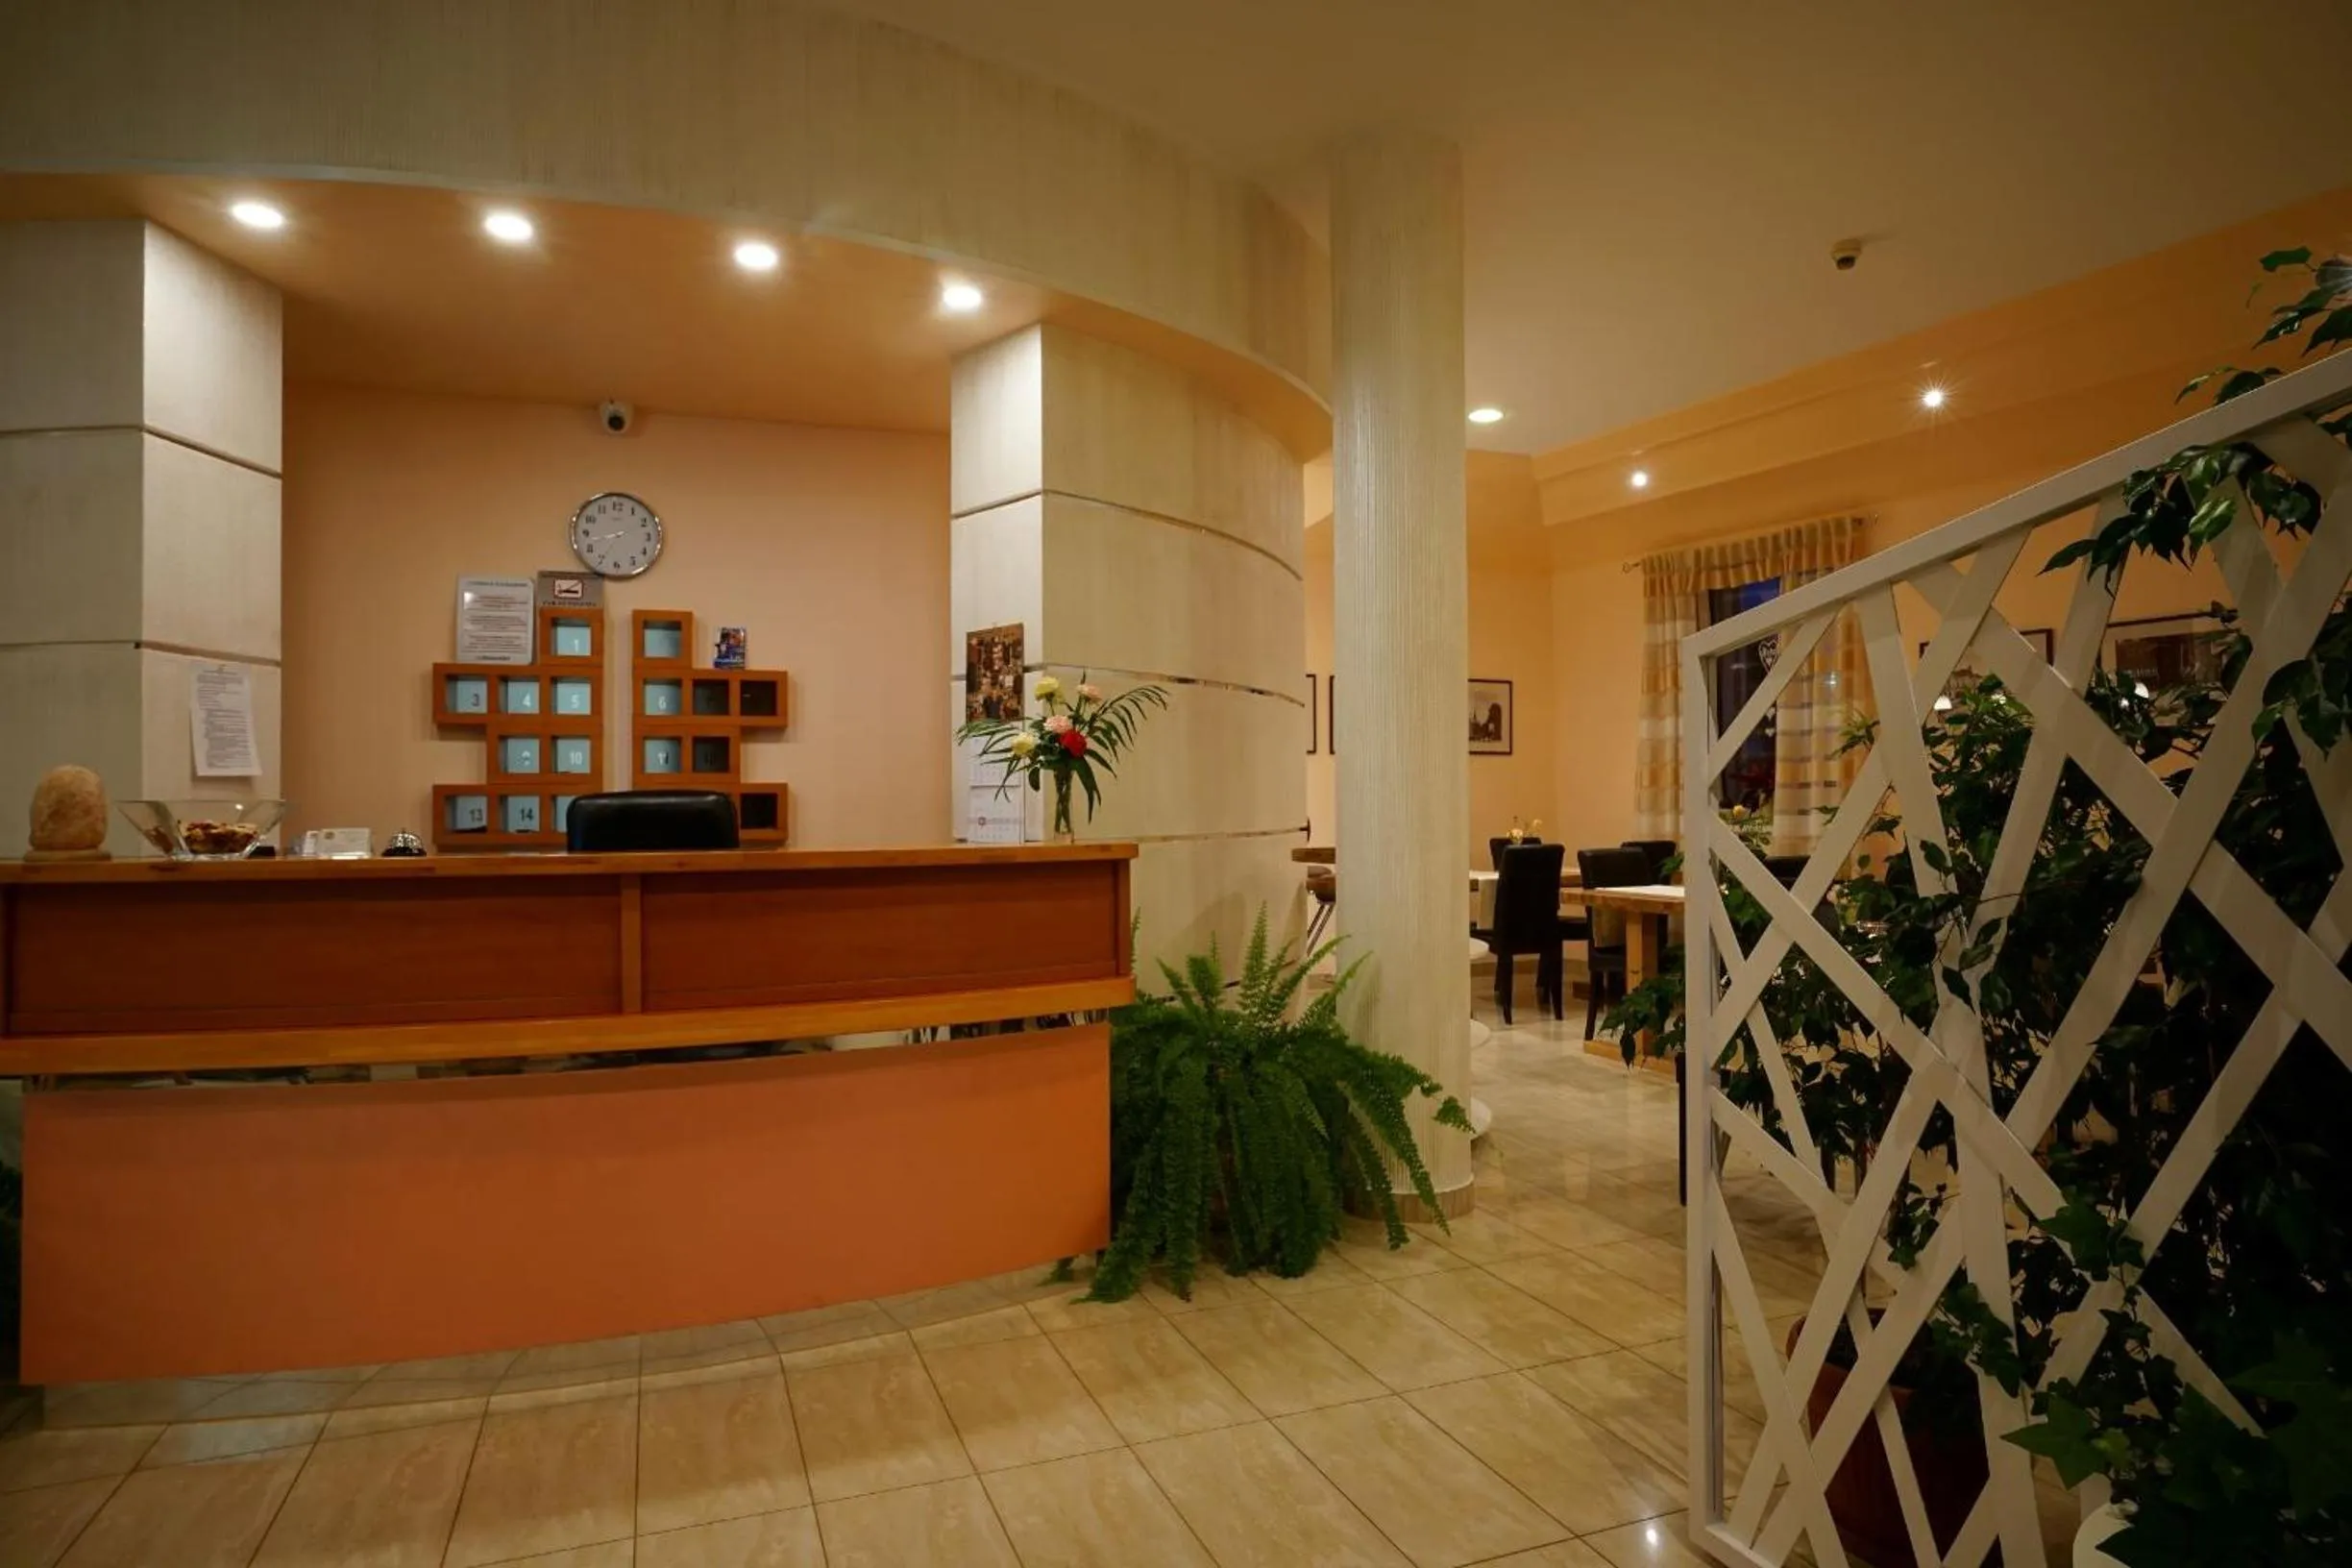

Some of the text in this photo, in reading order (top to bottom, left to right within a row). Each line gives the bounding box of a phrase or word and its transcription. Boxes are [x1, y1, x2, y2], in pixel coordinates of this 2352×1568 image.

[598, 503, 606, 514] 11
[612, 501, 624, 511] 12
[630, 506, 636, 516] 1
[585, 514, 597, 524] 10
[640, 517, 648, 527] 2
[582, 528, 590, 537] 9
[646, 532, 651, 542] 3
[586, 544, 594, 553] 8
[641, 547, 648, 556] 4
[629, 555, 636, 566] 5
[574, 639, 579, 651] 1
[472, 694, 480, 707] 3
[522, 693, 531, 707] 4
[571, 694, 580, 708] 5
[658, 696, 667, 710] 6
[570, 751, 583, 765] 10
[469, 808, 483, 822] 13
[519, 808, 533, 822] 14
